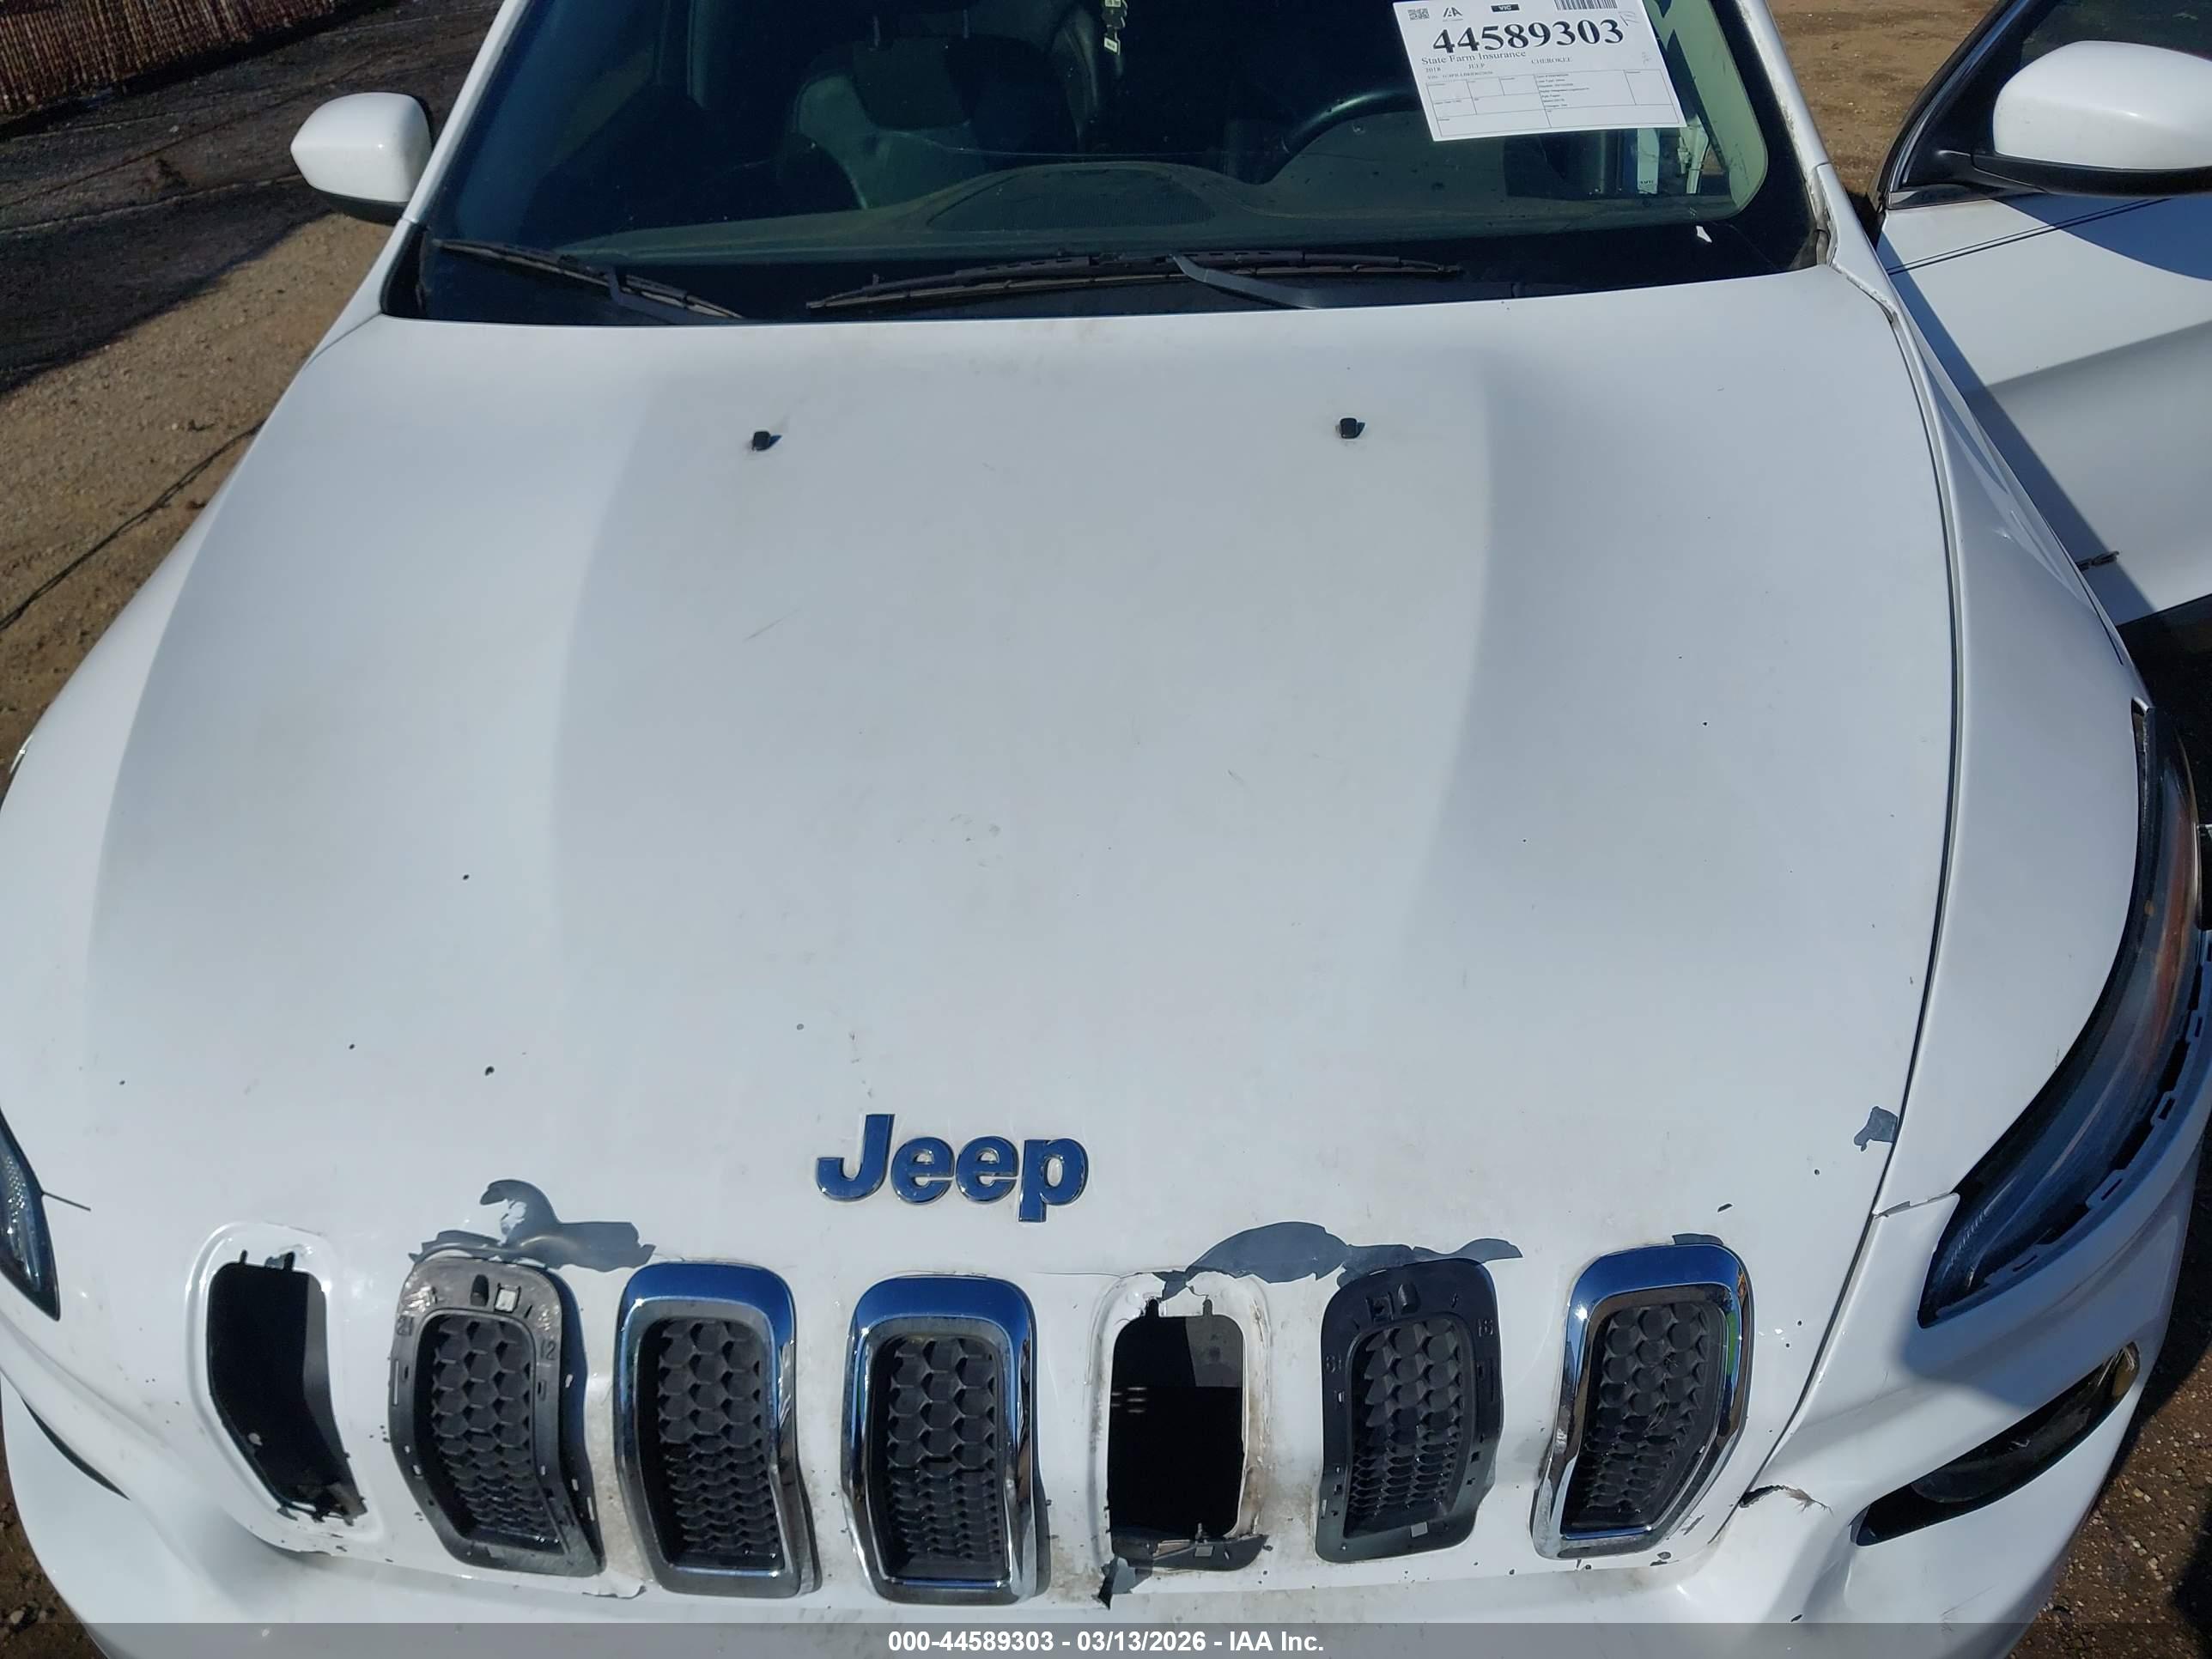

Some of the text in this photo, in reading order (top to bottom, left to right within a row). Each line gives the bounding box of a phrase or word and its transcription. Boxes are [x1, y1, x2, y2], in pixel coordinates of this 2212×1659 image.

[1432, 18, 1624, 53] 44589303
[1421, 50, 1526, 65] State Farm Insurance
[817, 1114, 1089, 1223] Jeep
[539, 1339, 558, 1361] 12
